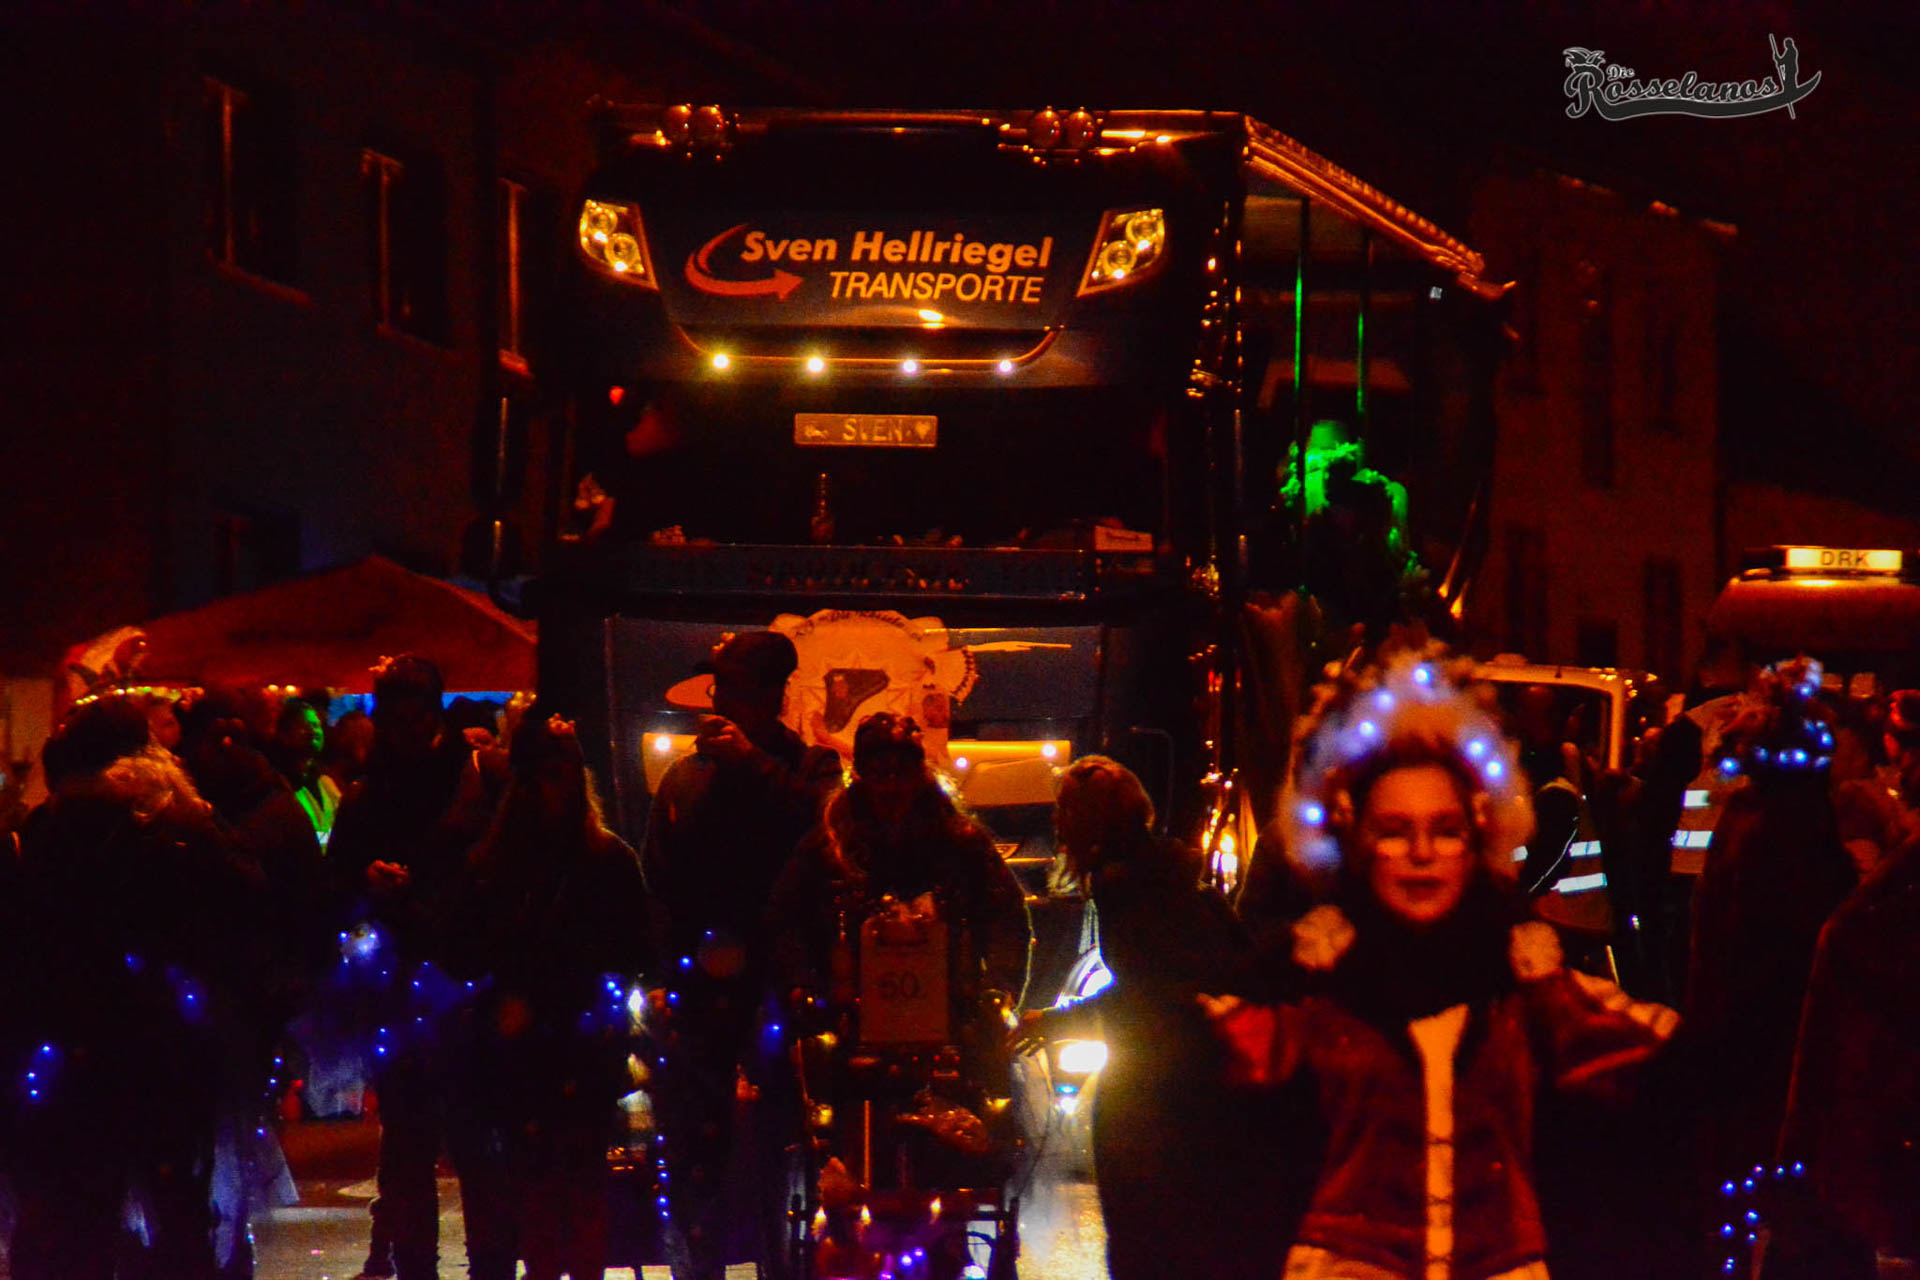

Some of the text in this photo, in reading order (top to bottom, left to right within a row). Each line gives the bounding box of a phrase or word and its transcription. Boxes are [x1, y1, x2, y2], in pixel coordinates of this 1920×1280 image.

[741, 230, 1053, 273] Sven Hellriegel
[829, 271, 1045, 303] TRANSPORTE
[1820, 550, 1869, 568] DRK
